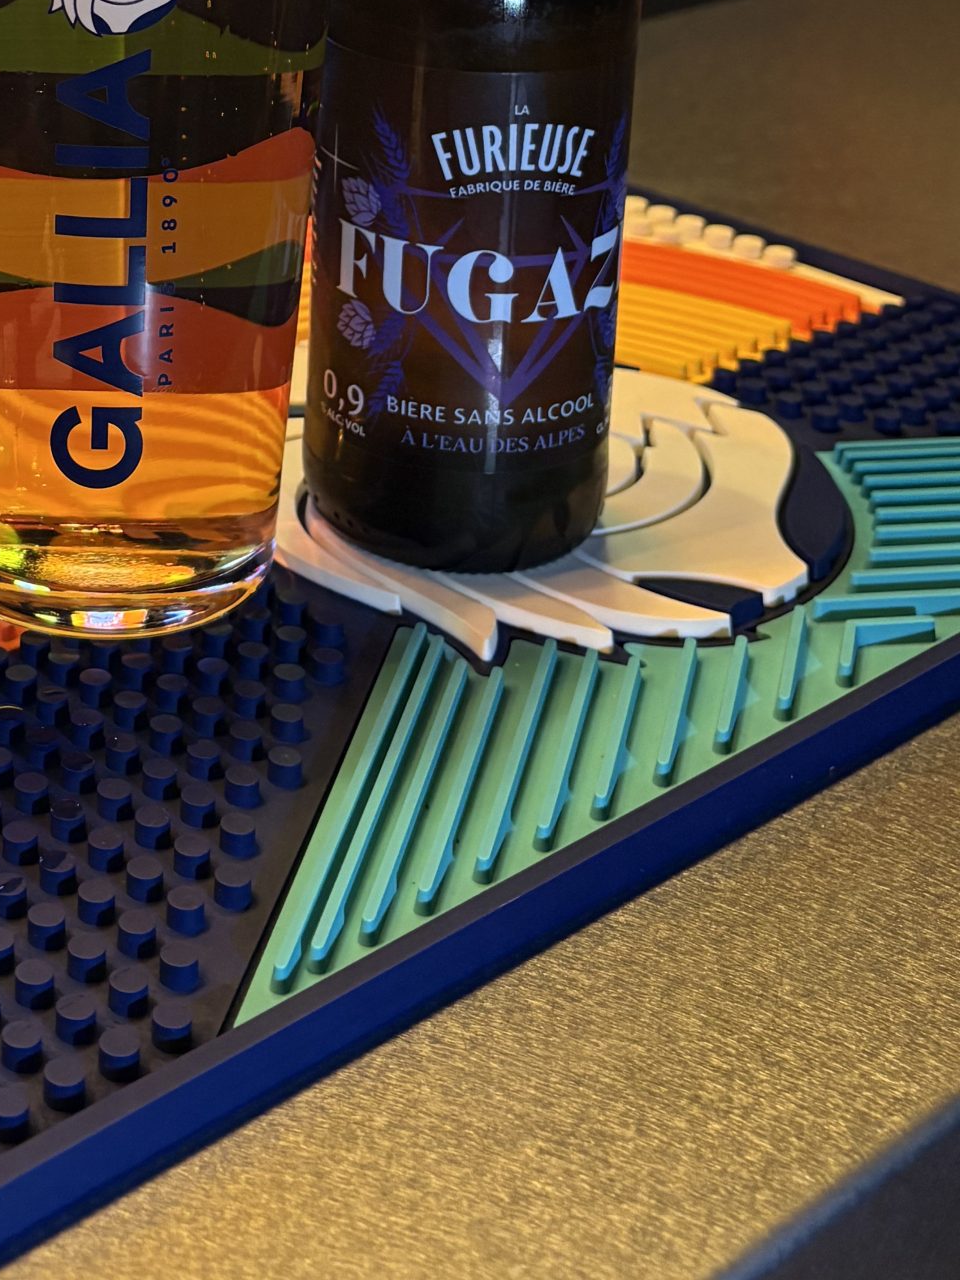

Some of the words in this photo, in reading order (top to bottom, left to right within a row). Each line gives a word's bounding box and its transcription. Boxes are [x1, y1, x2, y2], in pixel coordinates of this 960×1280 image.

[514, 105, 530, 115] LA
[431, 123, 595, 181] FURIEUSE
[449, 180, 520, 198] FABRIQUE
[523, 180, 541, 190] DE
[50, 49, 152, 489] GALLIA
[336, 218, 619, 324] FUGAZ
[158, 282, 176, 387] PARIS
[323, 369, 364, 416] 0,9
[454, 407, 515, 426] SANS
[521, 392, 594, 424] ALCOOL
[422, 432, 483, 454] L'EAU
[491, 436, 530, 454] DES
[533, 424, 586, 451] ALPES
